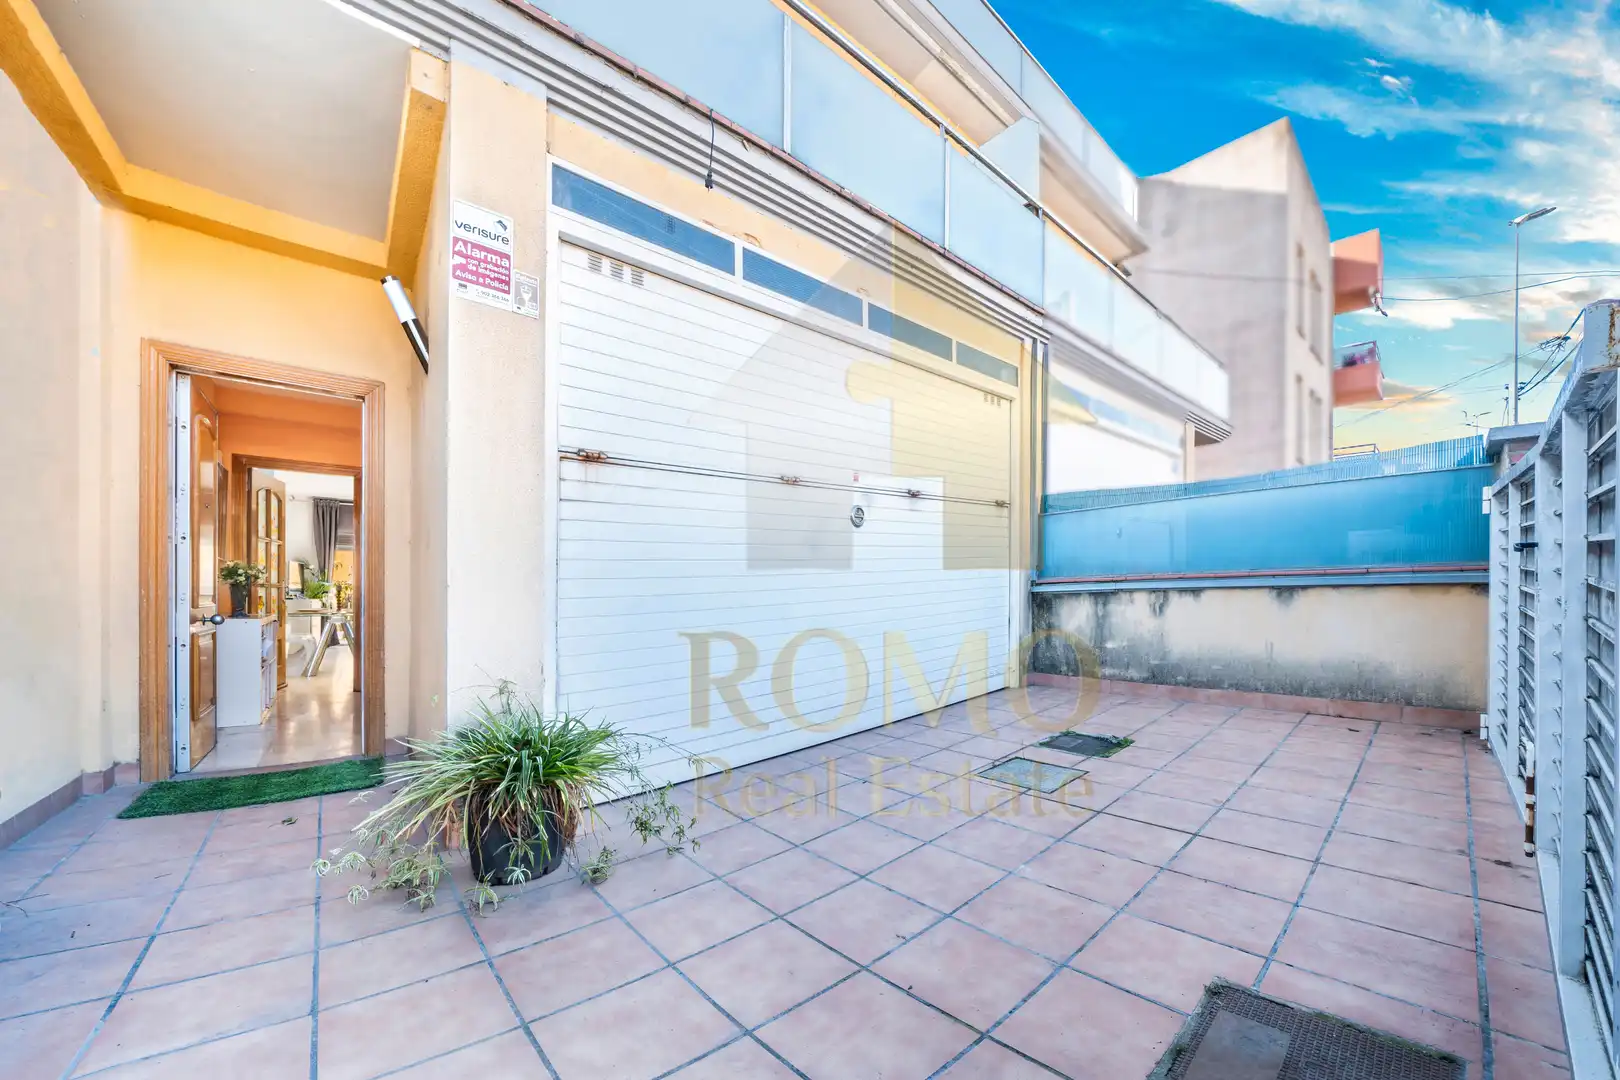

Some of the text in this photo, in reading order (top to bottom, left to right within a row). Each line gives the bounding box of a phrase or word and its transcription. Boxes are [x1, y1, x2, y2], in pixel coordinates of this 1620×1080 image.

[454, 219, 510, 245] verisure
[454, 241, 510, 268] Alarma
[467, 257, 479, 266] con
[467, 263, 477, 272] de
